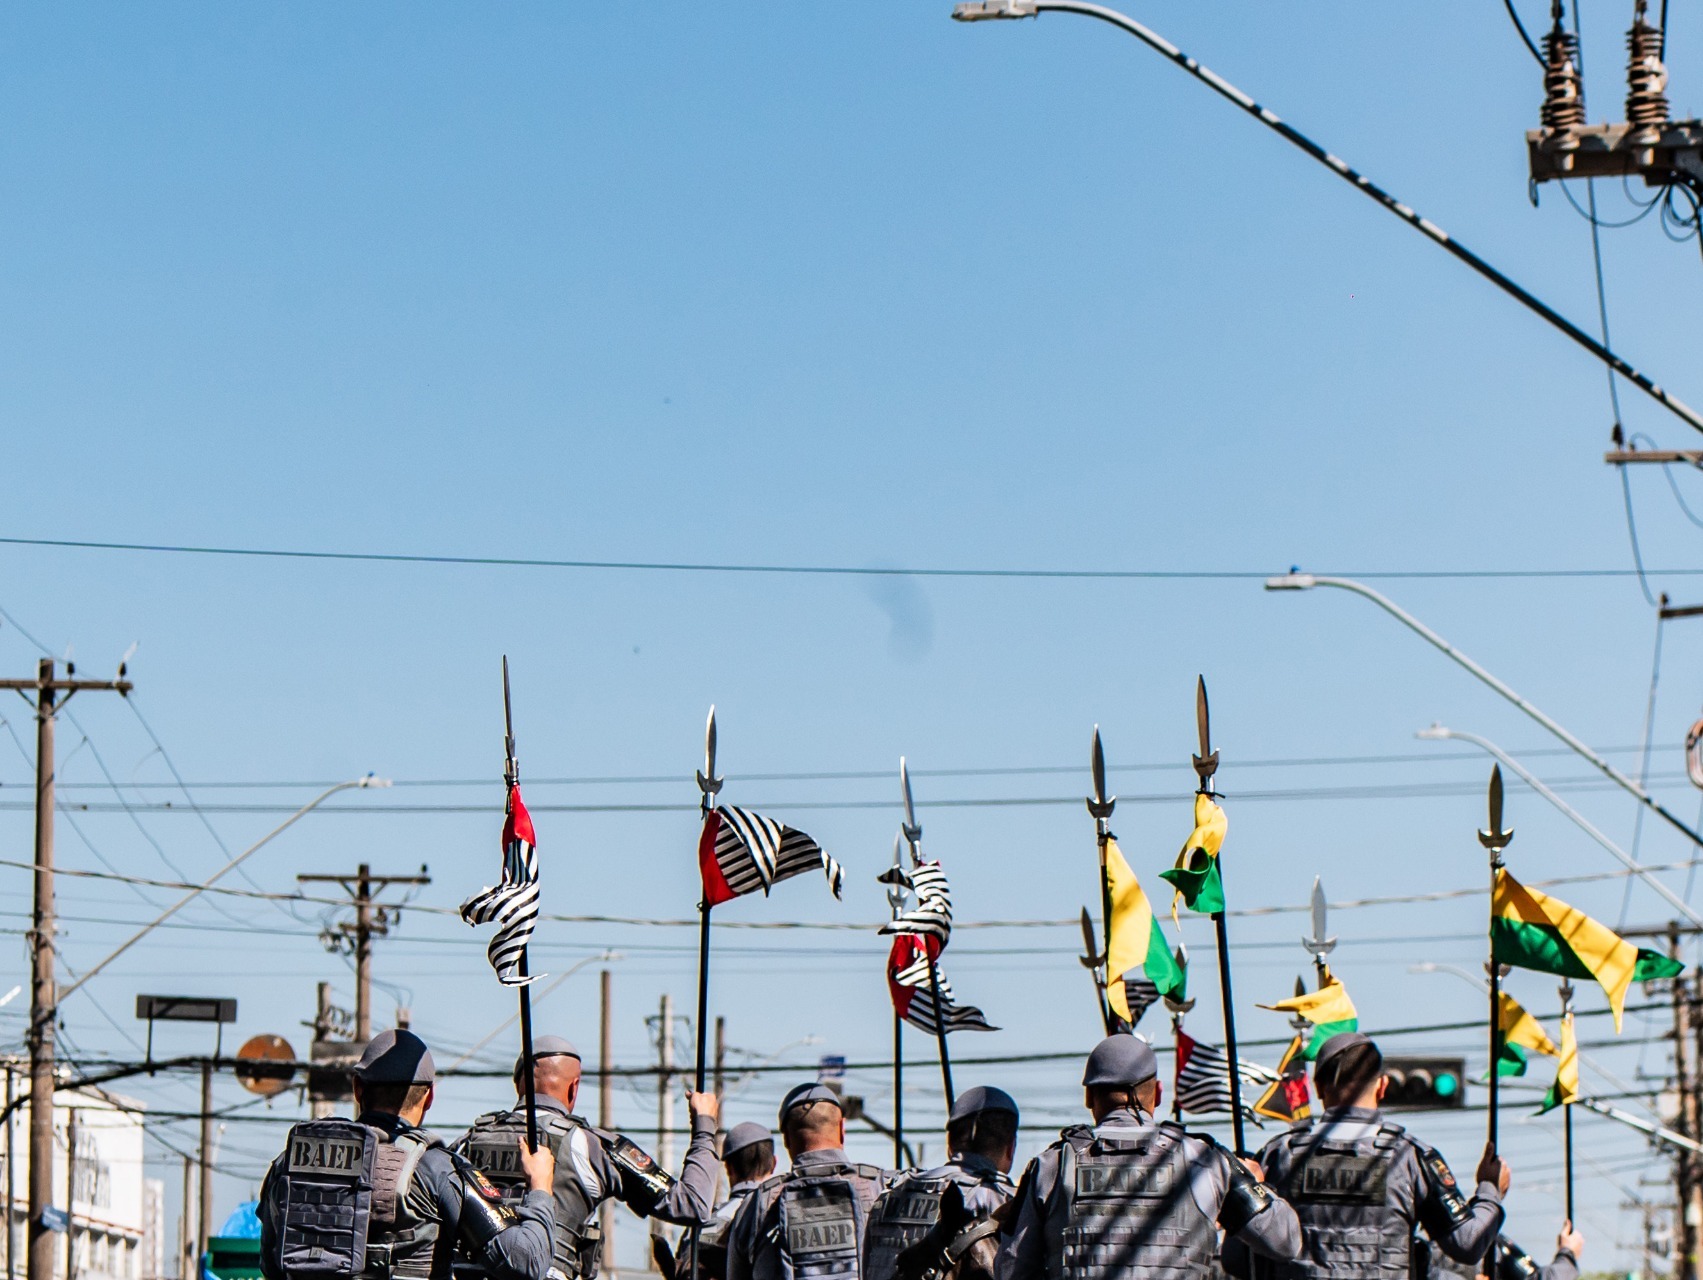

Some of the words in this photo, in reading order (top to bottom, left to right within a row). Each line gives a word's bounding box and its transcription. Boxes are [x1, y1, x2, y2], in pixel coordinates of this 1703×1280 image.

[293, 1142, 361, 1169] BAEP
[1081, 1169, 1166, 1193] BAEP
[791, 1224, 853, 1249] BAEP
